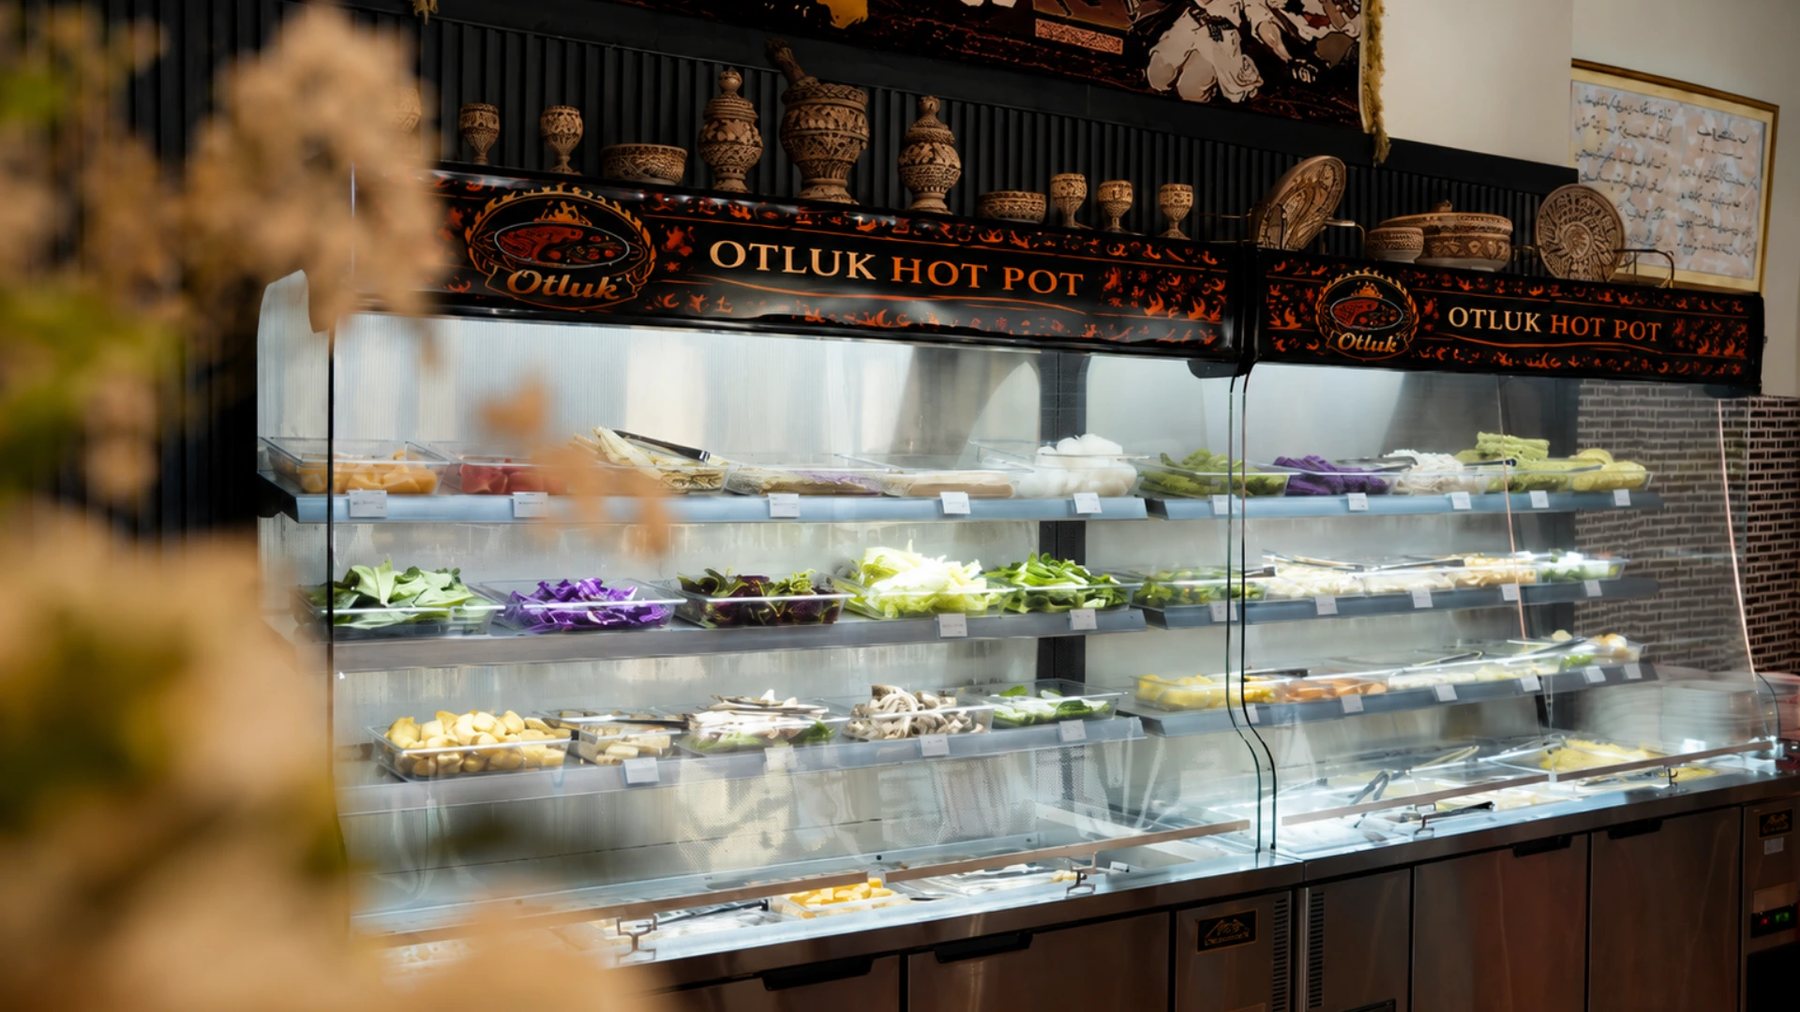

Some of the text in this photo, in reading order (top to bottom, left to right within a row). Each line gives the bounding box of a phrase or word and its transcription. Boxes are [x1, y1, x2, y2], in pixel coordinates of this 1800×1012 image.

[507, 269, 620, 300] Otluk
[709, 239, 1084, 297] OTLUK HOT POT
[1448, 306, 1662, 343] OTLUK HOT POT
[1338, 332, 1397, 353] Otluk
